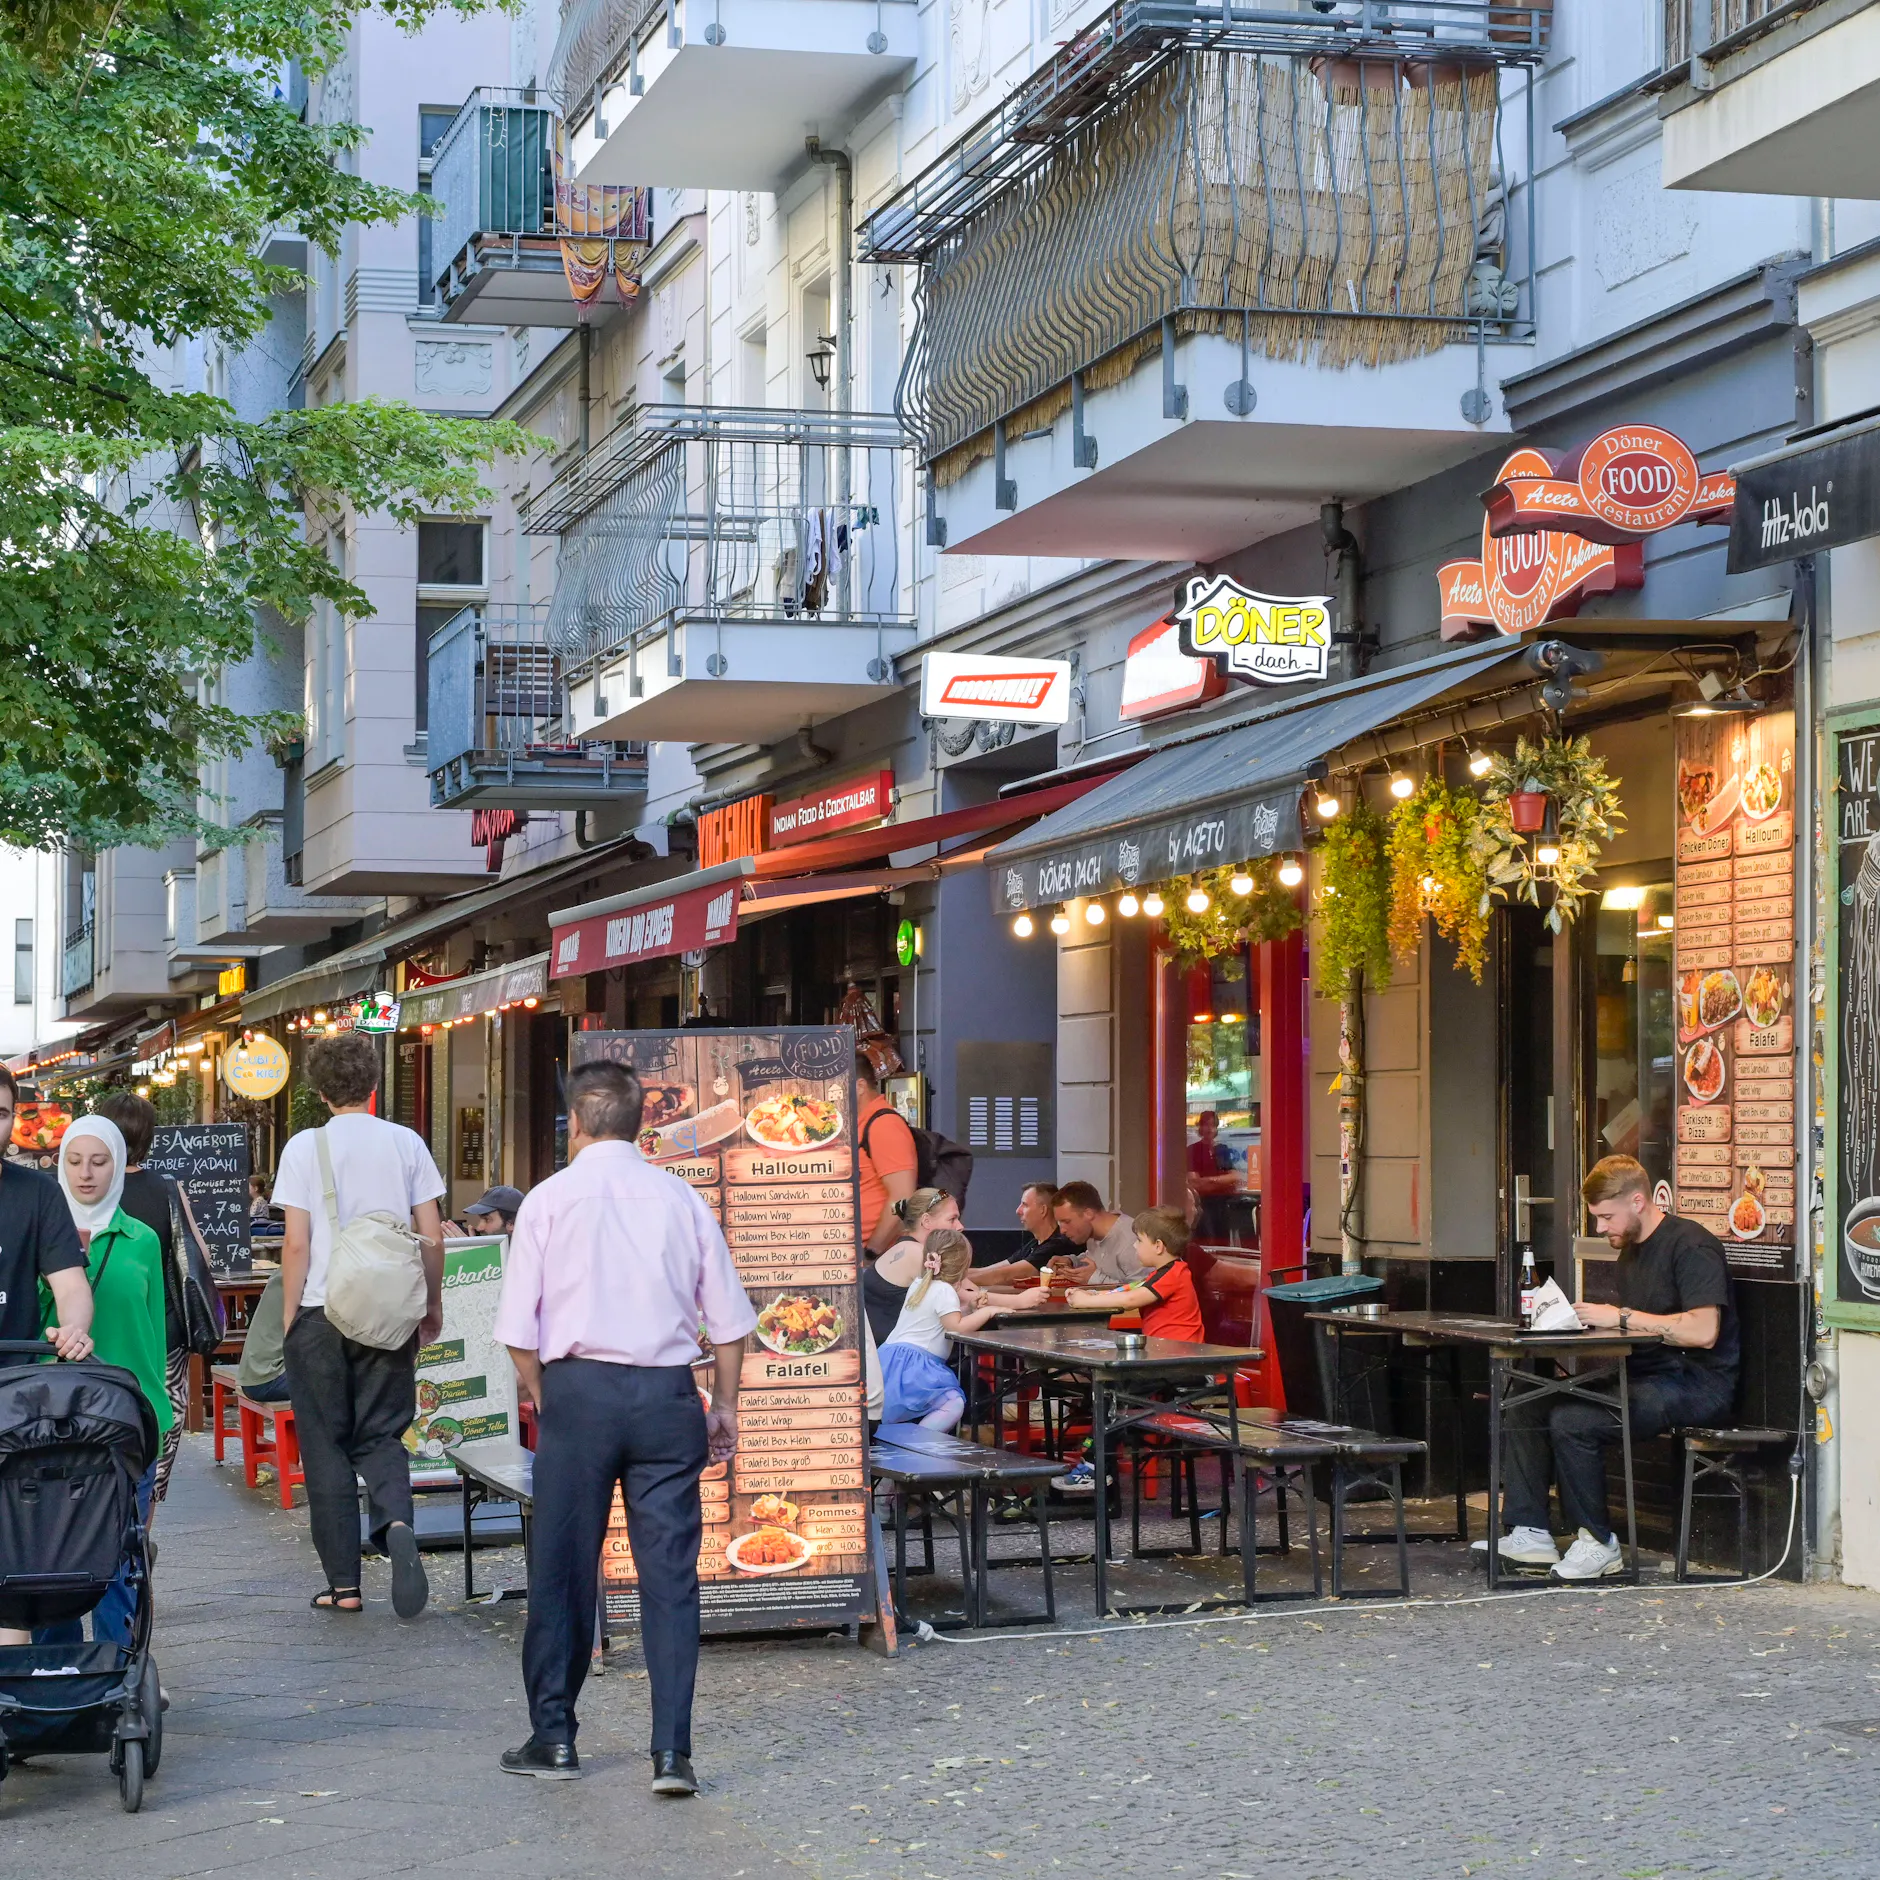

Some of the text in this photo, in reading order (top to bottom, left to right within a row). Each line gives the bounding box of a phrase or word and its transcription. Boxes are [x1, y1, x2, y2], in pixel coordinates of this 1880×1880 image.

[1603, 434, 1662, 455] Döner
[1608, 466, 1671, 495] FOOD
[1524, 484, 1579, 508] Aceto
[1591, 484, 1690, 526] Restaurant
[1448, 571, 1483, 606] Aceto
[1489, 551, 1558, 627] Restaurant
[1196, 598, 1325, 645] DÖNER
[1254, 648, 1301, 669] dach
[1848, 740, 1876, 793] WE
[774, 788, 875, 834] INDIAN FOOD & COCKTAILBAR
[725, 794, 762, 861] SHACK
[1746, 825, 1782, 844] Halloumi
[1168, 820, 1225, 862] by ACETO
[1680, 838, 1728, 854] Chicken Döner
[1038, 856, 1102, 896] DÖNER DACH
[606, 904, 674, 958] KOREAN BBQ EXPRESS
[1750, 1033, 1777, 1046] Falafel
[1682, 1114, 1712, 1126] Türkische
[1688, 1128, 1705, 1139] Pizza
[166, 1130, 244, 1154] ANGEBOTE
[192, 1157, 237, 1175] KADAHI
[666, 1165, 713, 1177] Döner
[752, 1160, 832, 1175] Halloumi
[189, 1178, 242, 1189] GEMÜSE MIT
[1767, 1173, 1789, 1184] Pommes
[733, 1192, 767, 1202] Halloumi
[769, 1189, 810, 1200] Sandwich
[1681, 1196, 1714, 1210] Currywurst
[734, 1212, 767, 1221] Halloumi
[770, 1211, 792, 1223] Wrap
[197, 1220, 240, 1238] SAAG
[734, 1232, 768, 1242] Halloumi
[770, 1230, 786, 1240] Box
[790, 1229, 810, 1240] klein
[735, 1253, 768, 1262] Halloumi
[771, 1251, 787, 1260] Box
[790, 1250, 810, 1264] groß
[772, 1272, 793, 1281] Teller
[419, 1344, 442, 1353] Seitan
[420, 1350, 459, 1362] Döner Box
[766, 1362, 828, 1377] Falafel
[441, 1380, 464, 1389] Seitan
[741, 1395, 767, 1406] Falafel
[770, 1394, 810, 1405] Sandwich
[462, 1417, 486, 1426] Seitan
[741, 1416, 768, 1426] Falafel
[770, 1418, 792, 1429] Wrap
[464, 1427, 485, 1436] Döner
[487, 1422, 506, 1431] Teller
[742, 1436, 768, 1447] Falafel
[772, 1435, 787, 1445] Box
[790, 1435, 811, 1444] klein
[743, 1457, 769, 1468] Falafel
[772, 1456, 788, 1466] Box
[791, 1455, 810, 1469] groß
[743, 1477, 770, 1488] Falafel
[774, 1477, 794, 1487] Teller
[809, 1509, 857, 1517] Pommes
[816, 1526, 833, 1534] klein
[817, 1542, 833, 1554] groß
